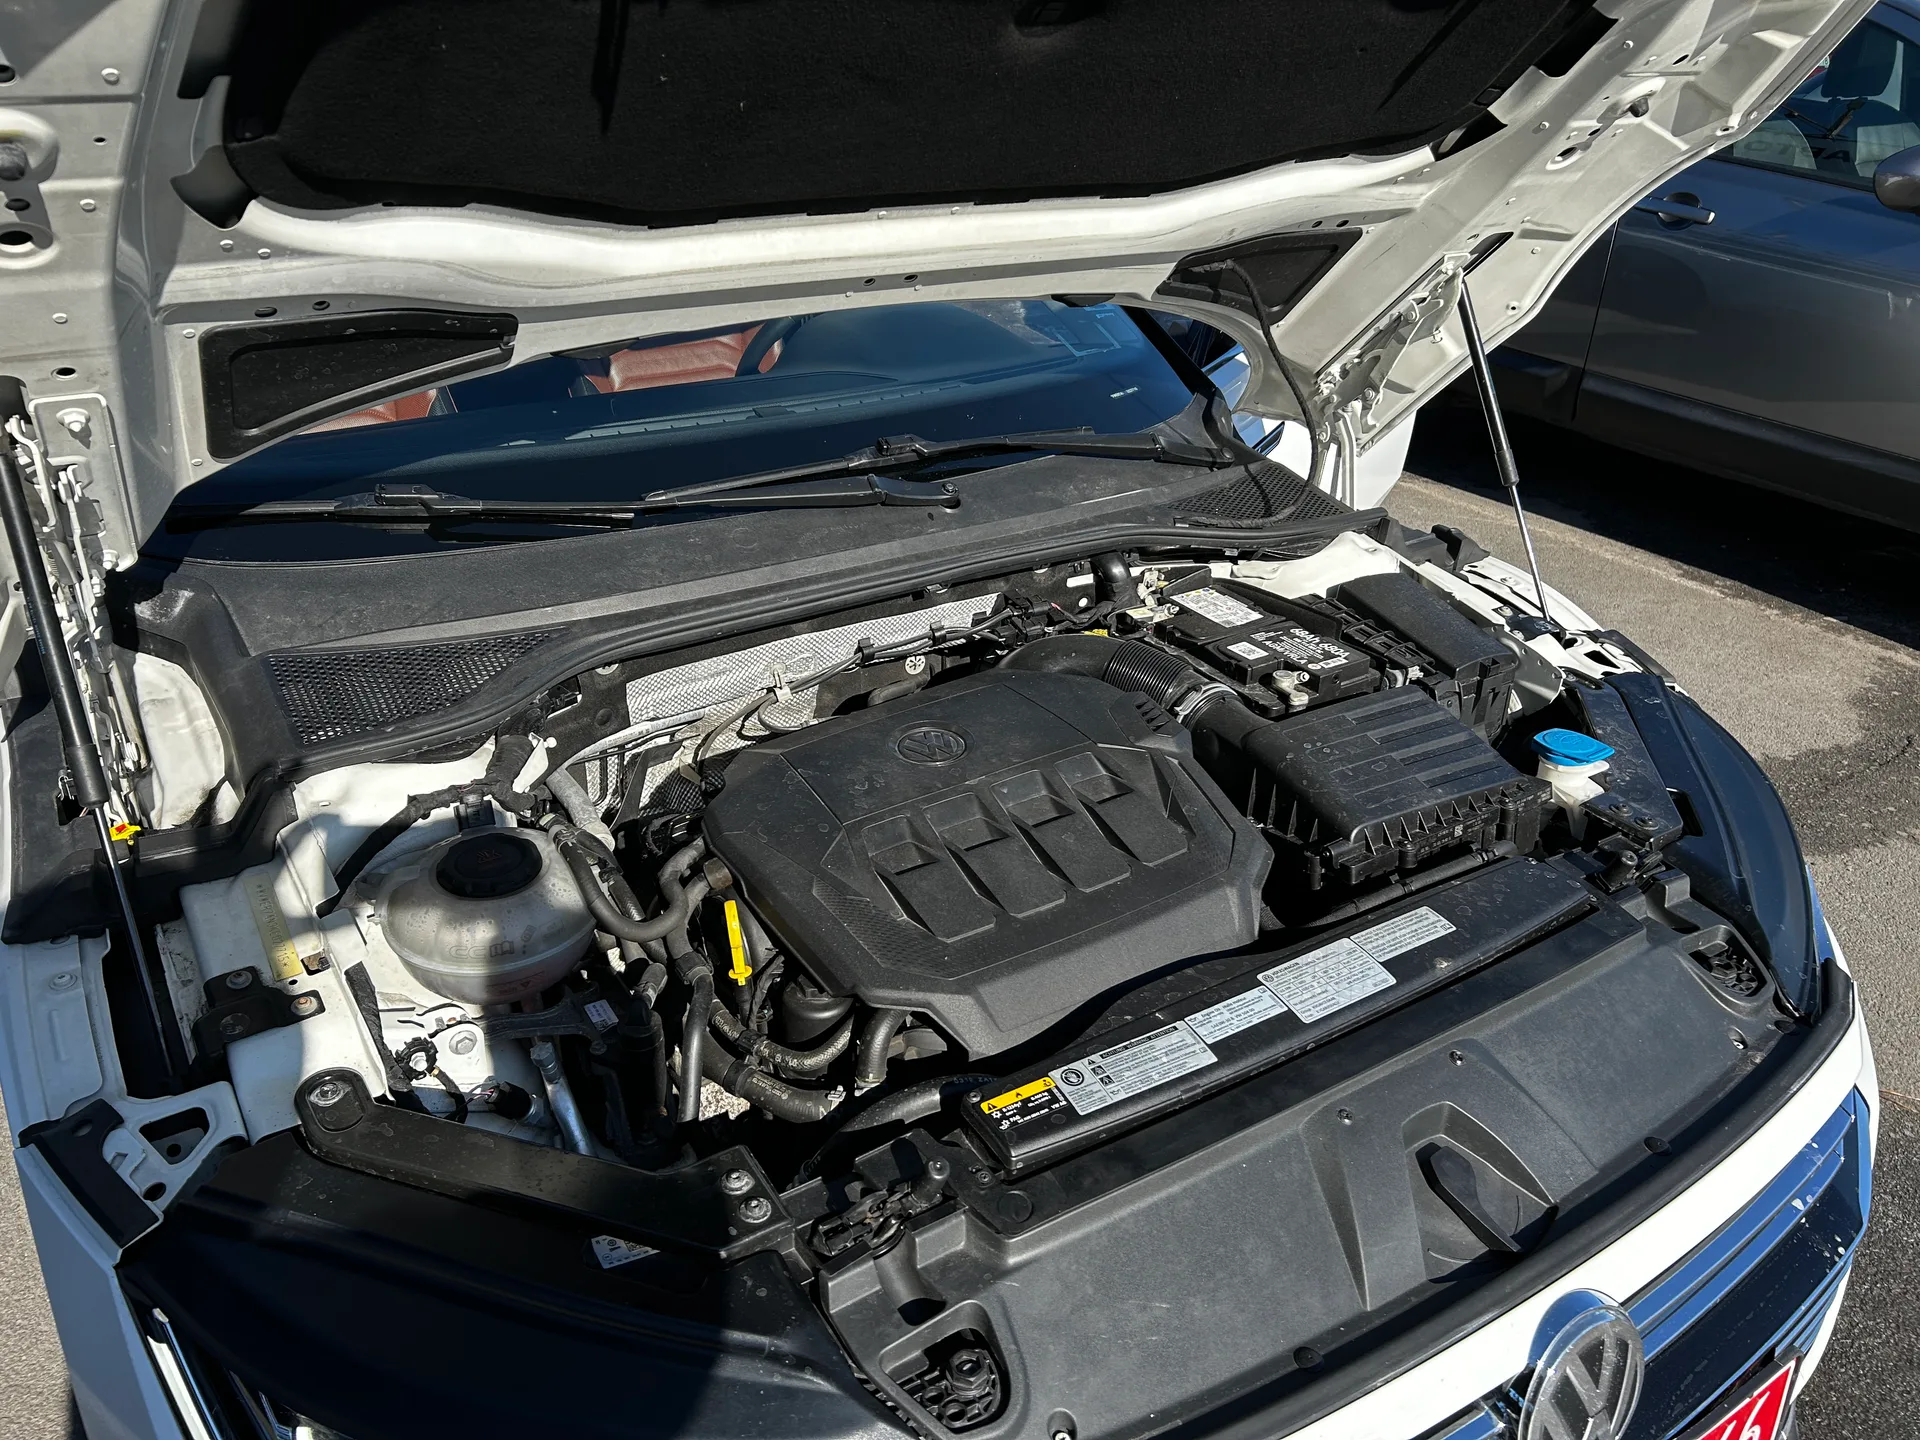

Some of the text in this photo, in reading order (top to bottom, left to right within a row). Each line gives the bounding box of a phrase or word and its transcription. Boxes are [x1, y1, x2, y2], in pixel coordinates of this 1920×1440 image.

[1290, 628, 1321, 644] 68Ah
[1126, 1035, 1151, 1049] WARNING
[1150, 1026, 1176, 1041] ATTENTION
